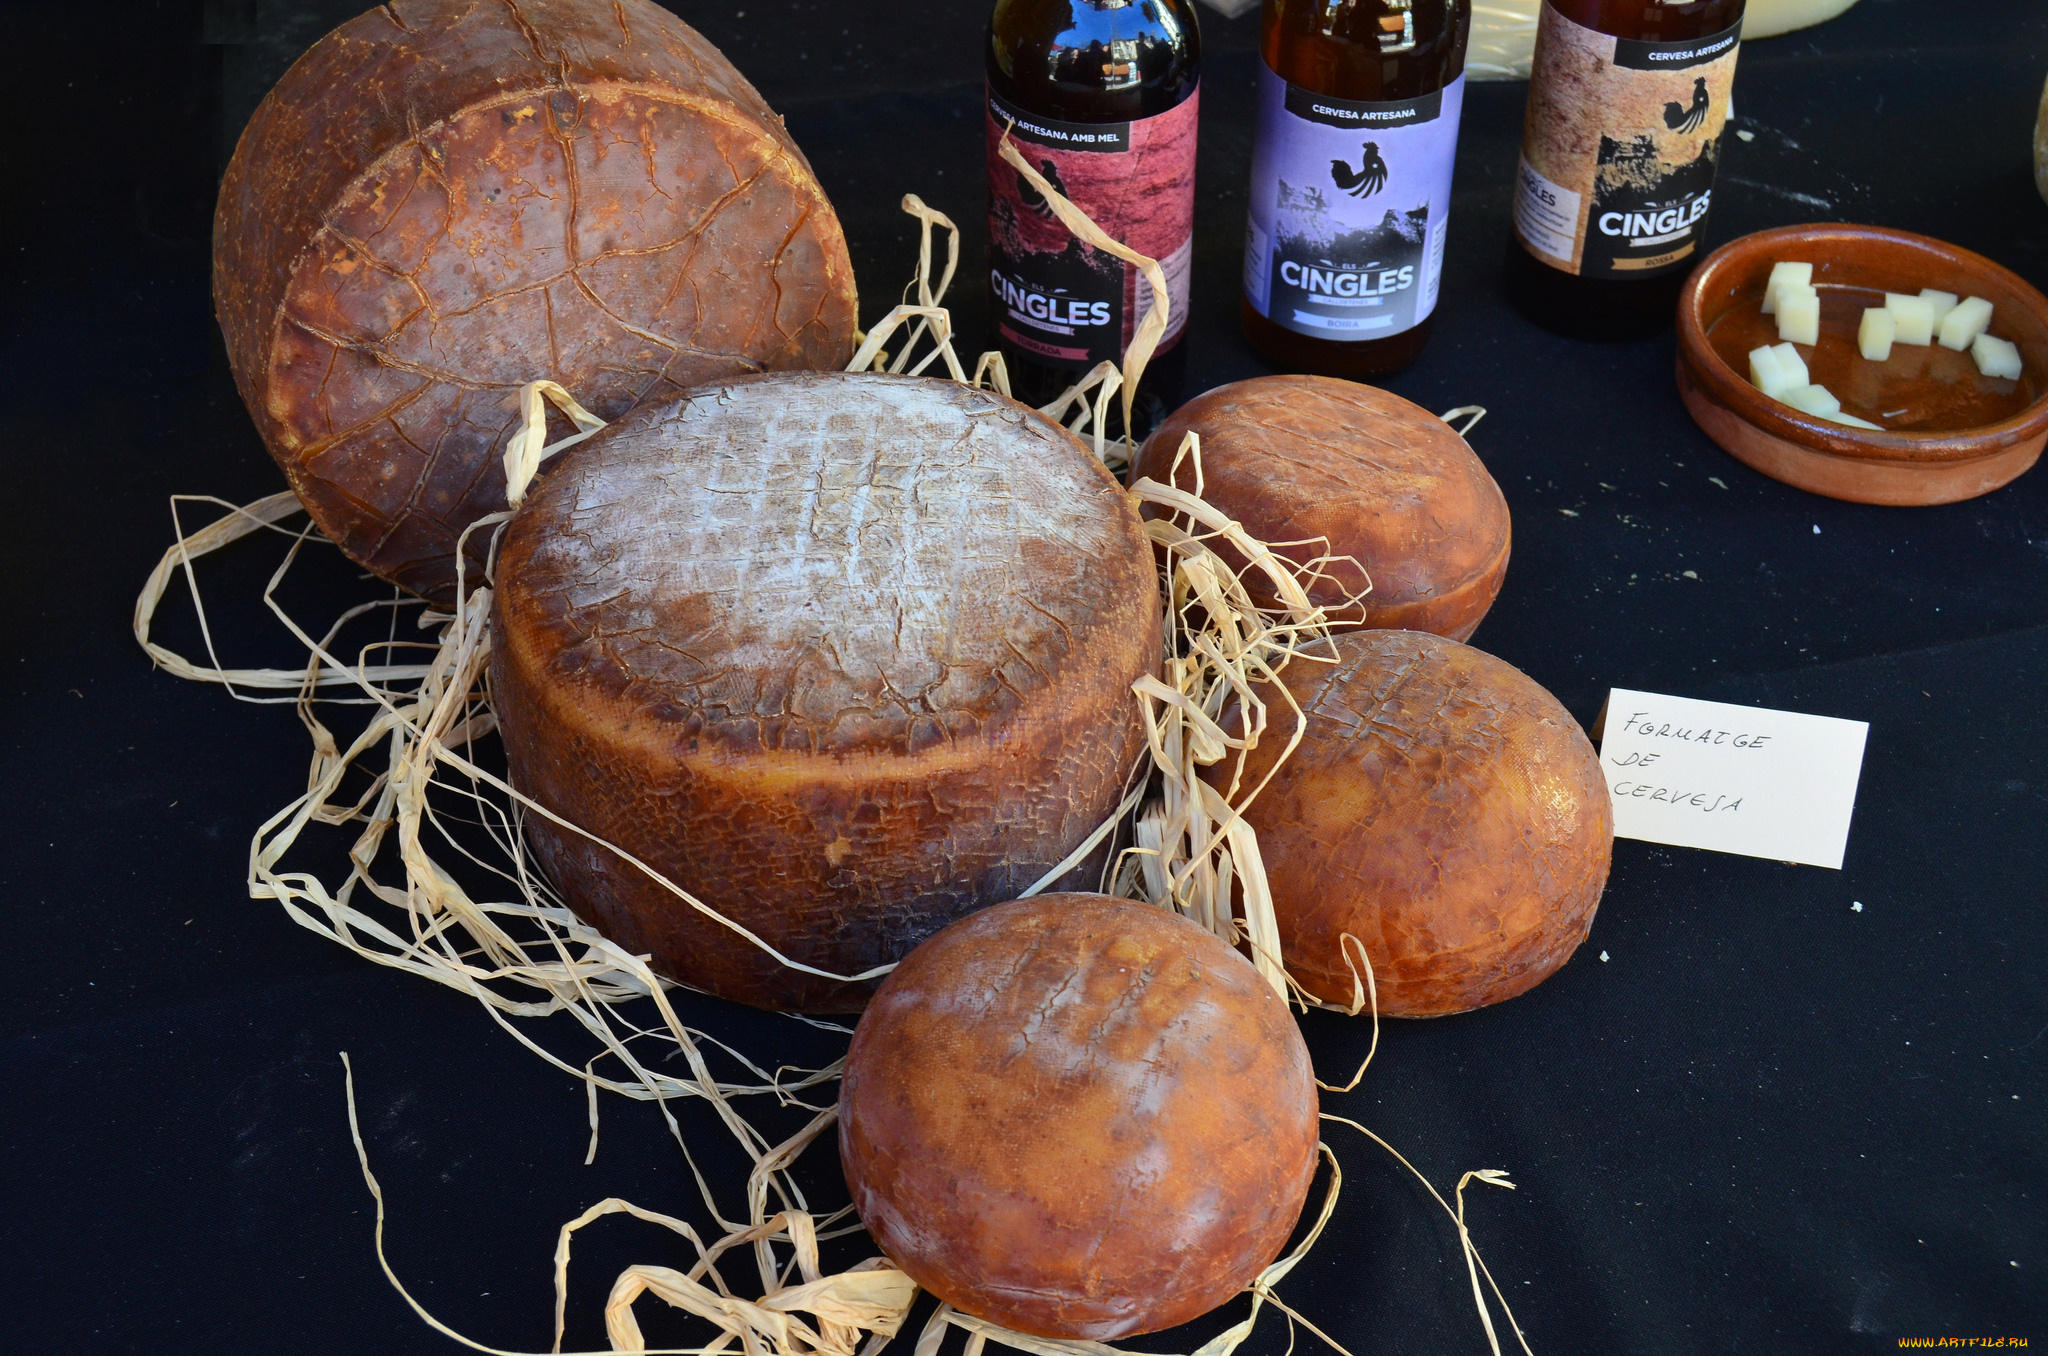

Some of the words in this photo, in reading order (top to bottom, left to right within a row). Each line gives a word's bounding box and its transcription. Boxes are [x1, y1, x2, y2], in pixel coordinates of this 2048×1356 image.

[1648, 51, 1694, 61] CERVESA
[1695, 36, 1735, 57] ARTESANA
[1312, 104, 1359, 119] CERVESA
[1361, 108, 1416, 120] ARTESANA
[1018, 120, 1068, 141] ARTESANA
[1071, 133, 1095, 143] AMB
[1098, 133, 1120, 142] MEL
[1599, 189, 1711, 237] CINGLES
[1281, 260, 1414, 297] CINGLES
[991, 269, 1111, 326] CINGLES
[1327, 319, 1360, 328] BOIRA
[1623, 711, 1772, 749] FORMATGE
[1611, 752, 1661, 767] DE
[1613, 781, 1744, 812] CERVESA
